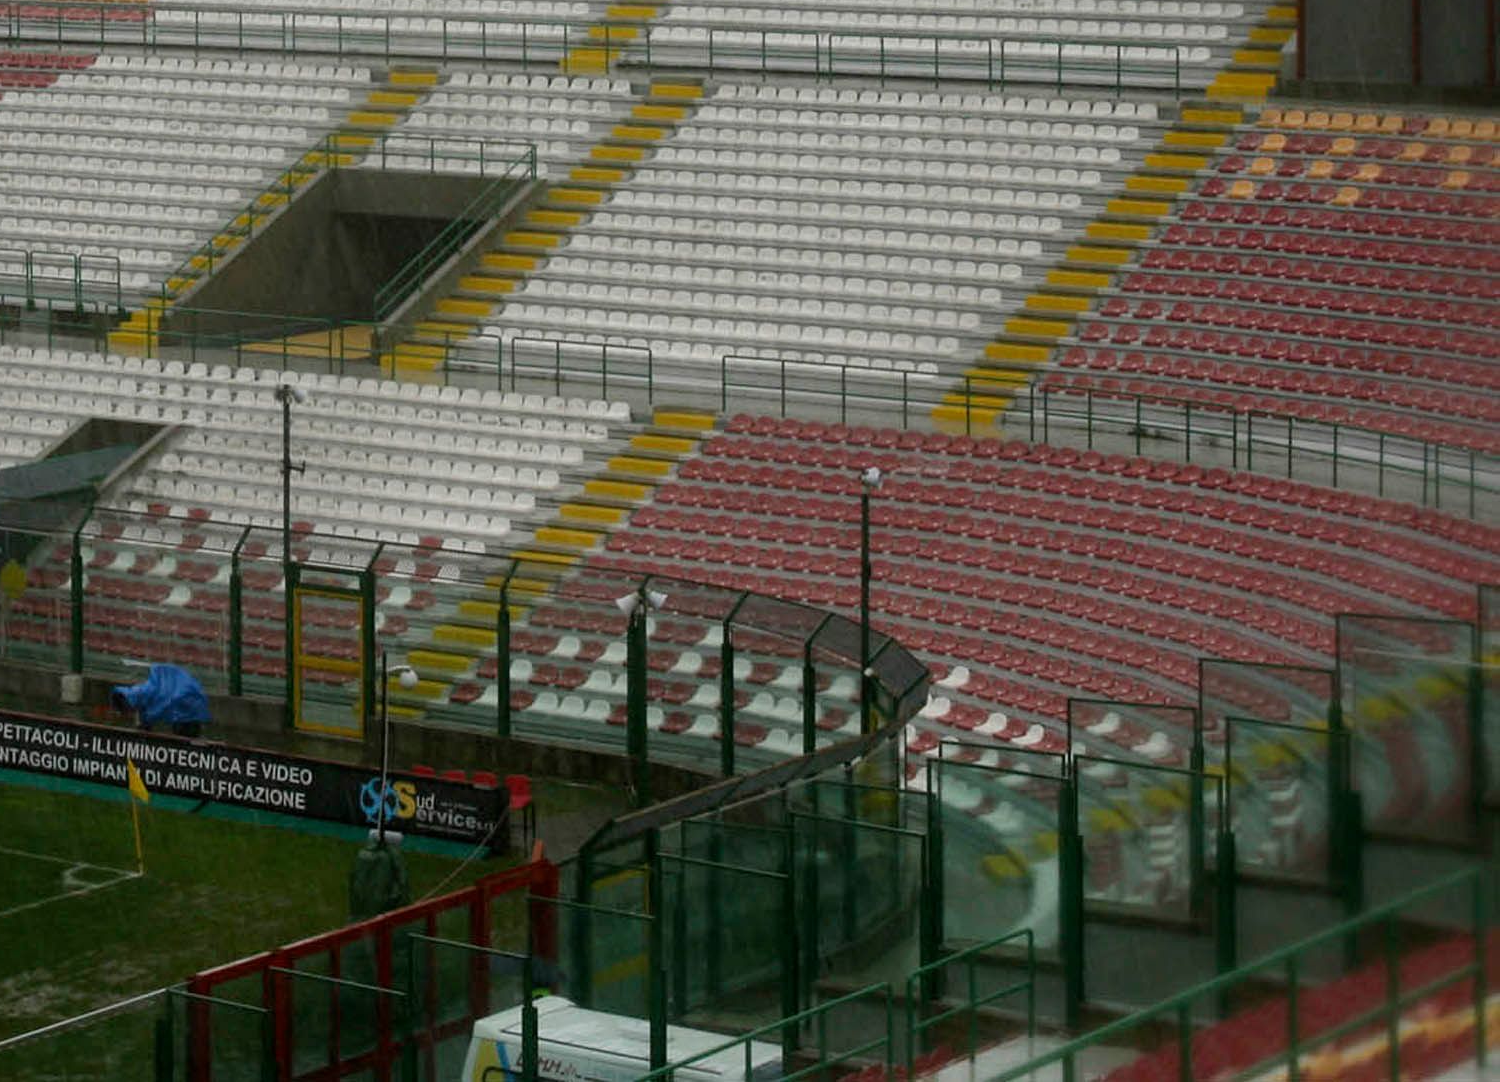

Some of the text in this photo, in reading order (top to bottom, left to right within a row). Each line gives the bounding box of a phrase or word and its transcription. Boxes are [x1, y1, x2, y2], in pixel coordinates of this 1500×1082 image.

[145, 768, 161, 786] DI
[165, 772, 306, 810] AMPLIFICAZIONE
[246, 760, 257, 778] E
[261, 761, 313, 786] VIDEO
